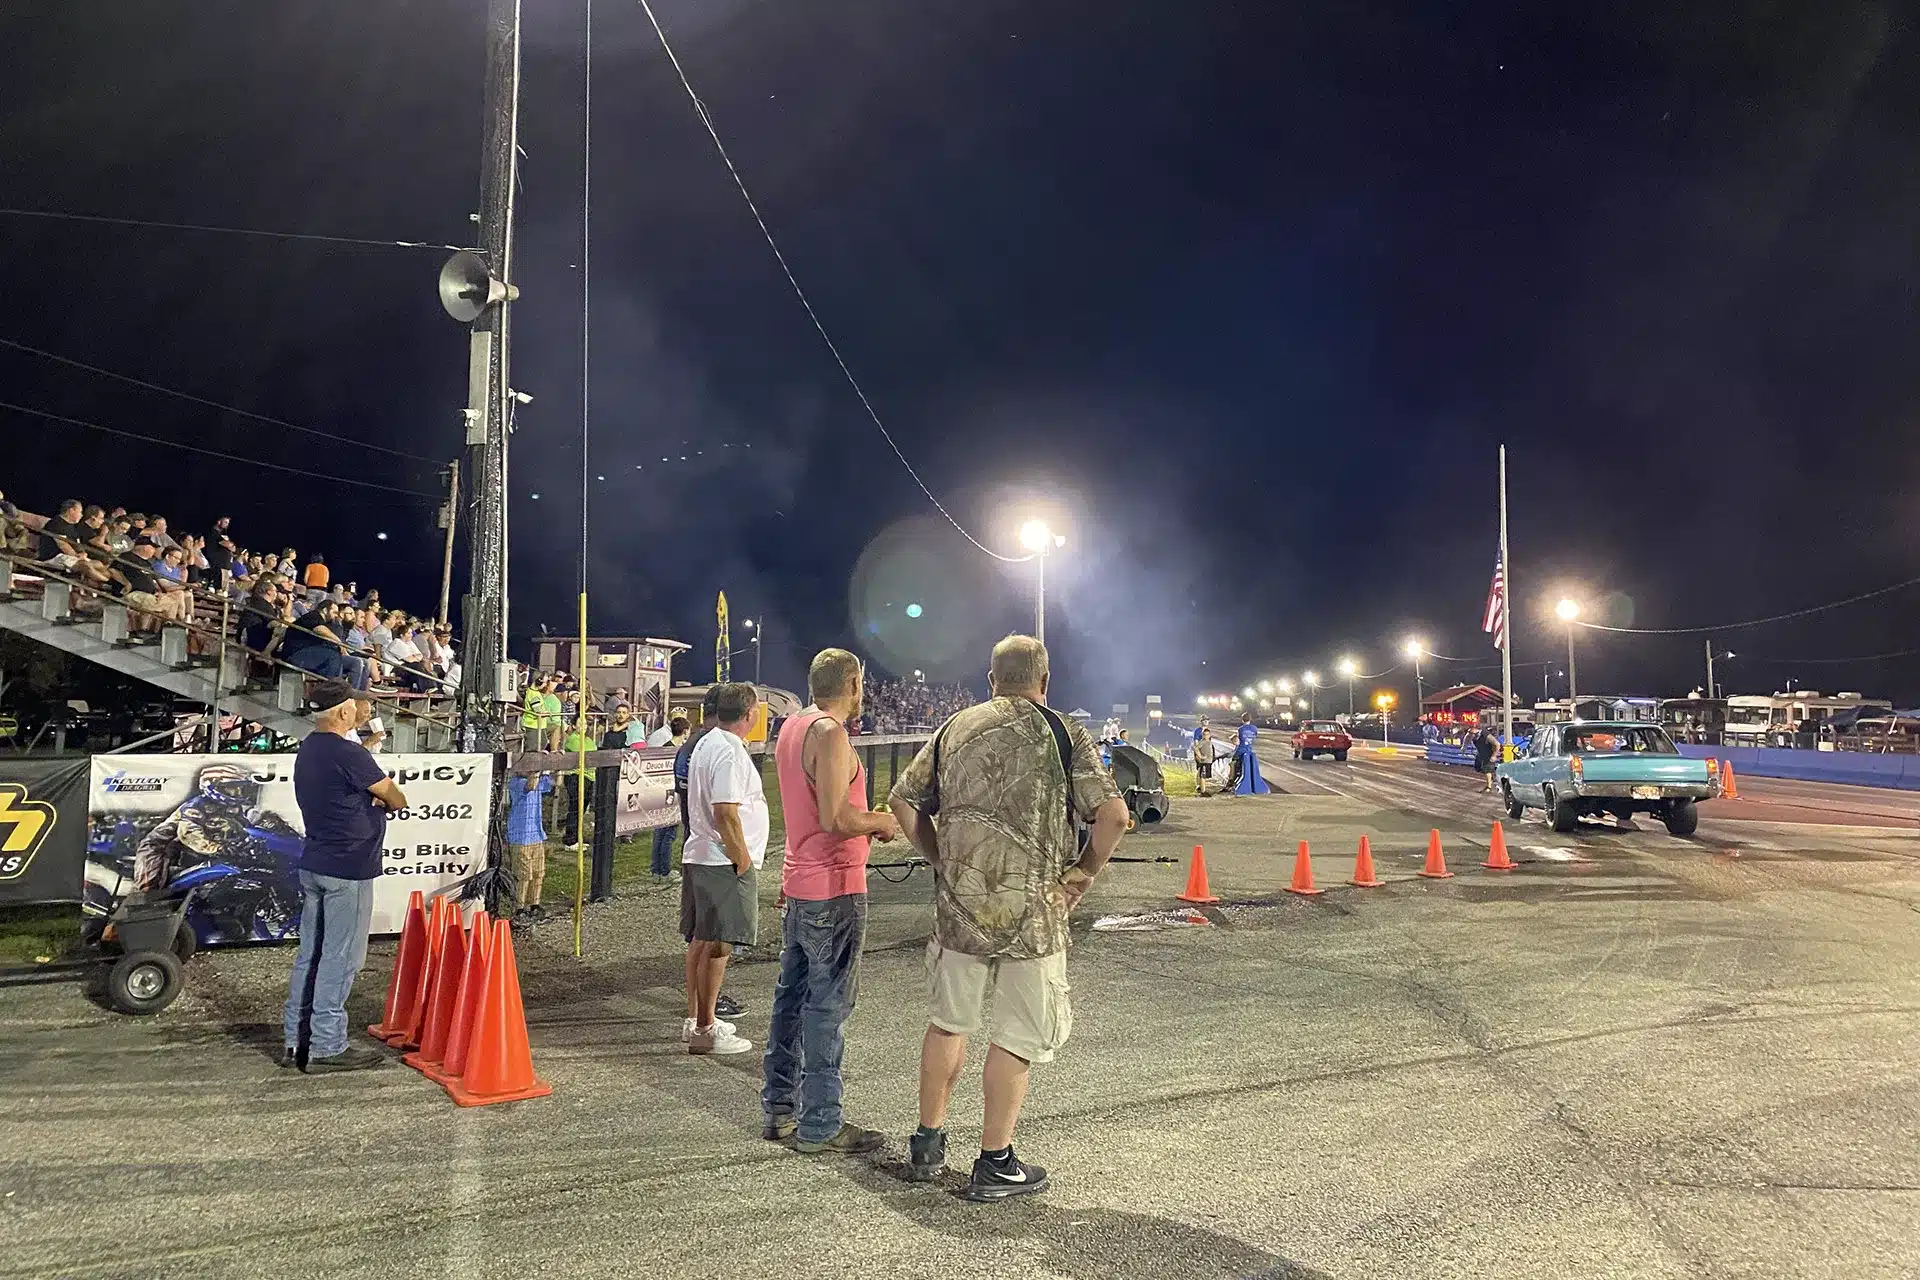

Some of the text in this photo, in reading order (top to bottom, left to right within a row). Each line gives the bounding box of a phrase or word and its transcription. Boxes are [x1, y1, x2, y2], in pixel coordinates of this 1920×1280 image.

[386, 804, 473, 821] 6-3462
[381, 843, 470, 860] ag Bike
[383, 861, 470, 876] ecialty
